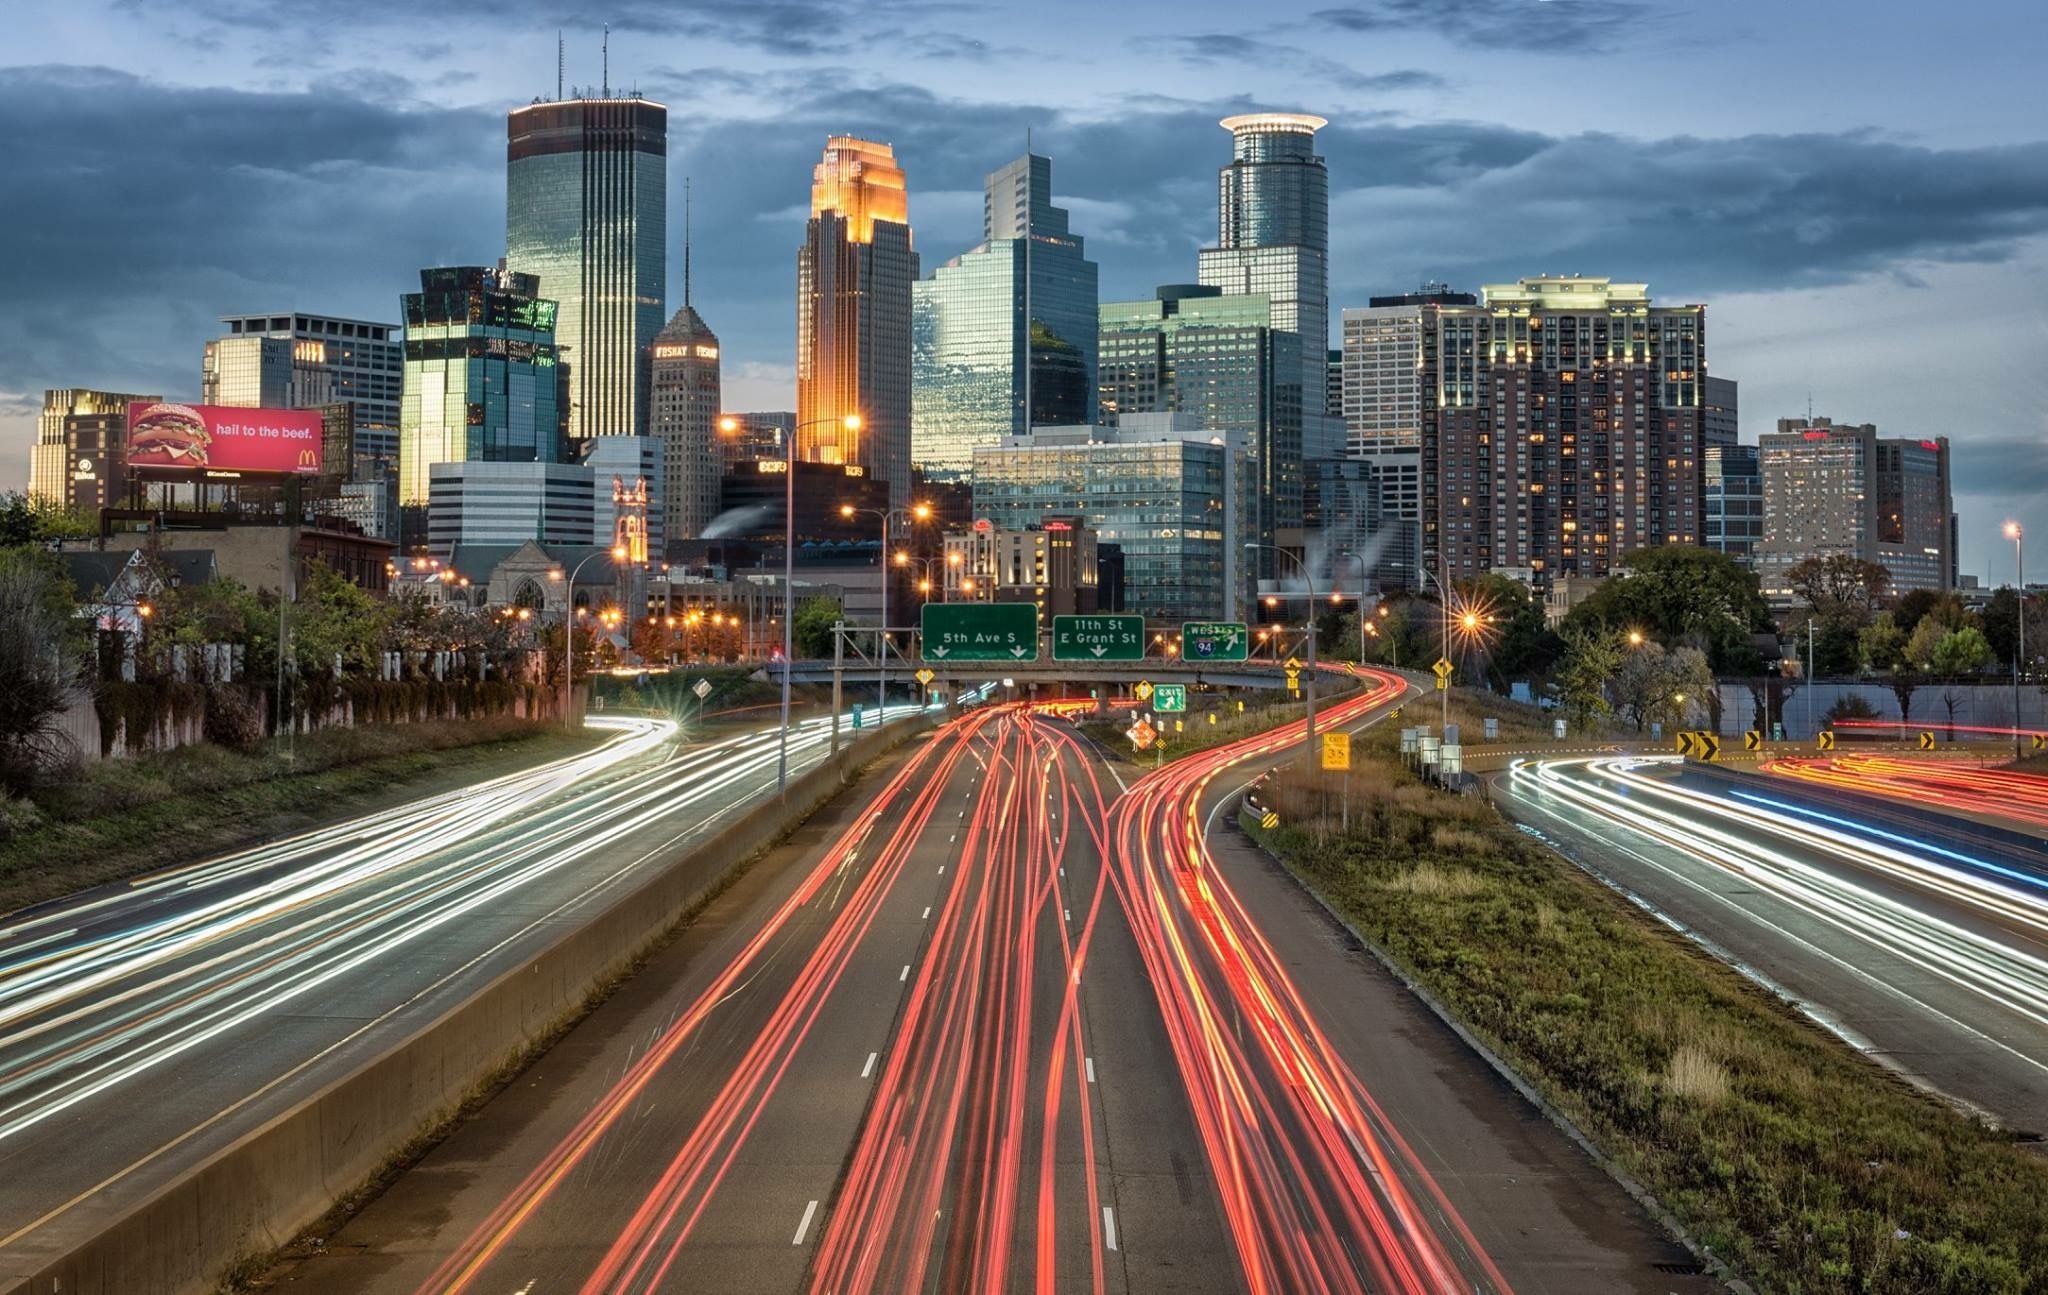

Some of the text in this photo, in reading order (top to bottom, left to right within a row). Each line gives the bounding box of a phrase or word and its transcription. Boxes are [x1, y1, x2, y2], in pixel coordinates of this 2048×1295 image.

[216, 424, 312, 439] hail to the beef.
[1075, 620, 1123, 630] 11th St
[943, 632, 1016, 643] 5th Ave S
[1061, 633, 1136, 643] E Grant St
[1198, 642, 1212, 652] 94
